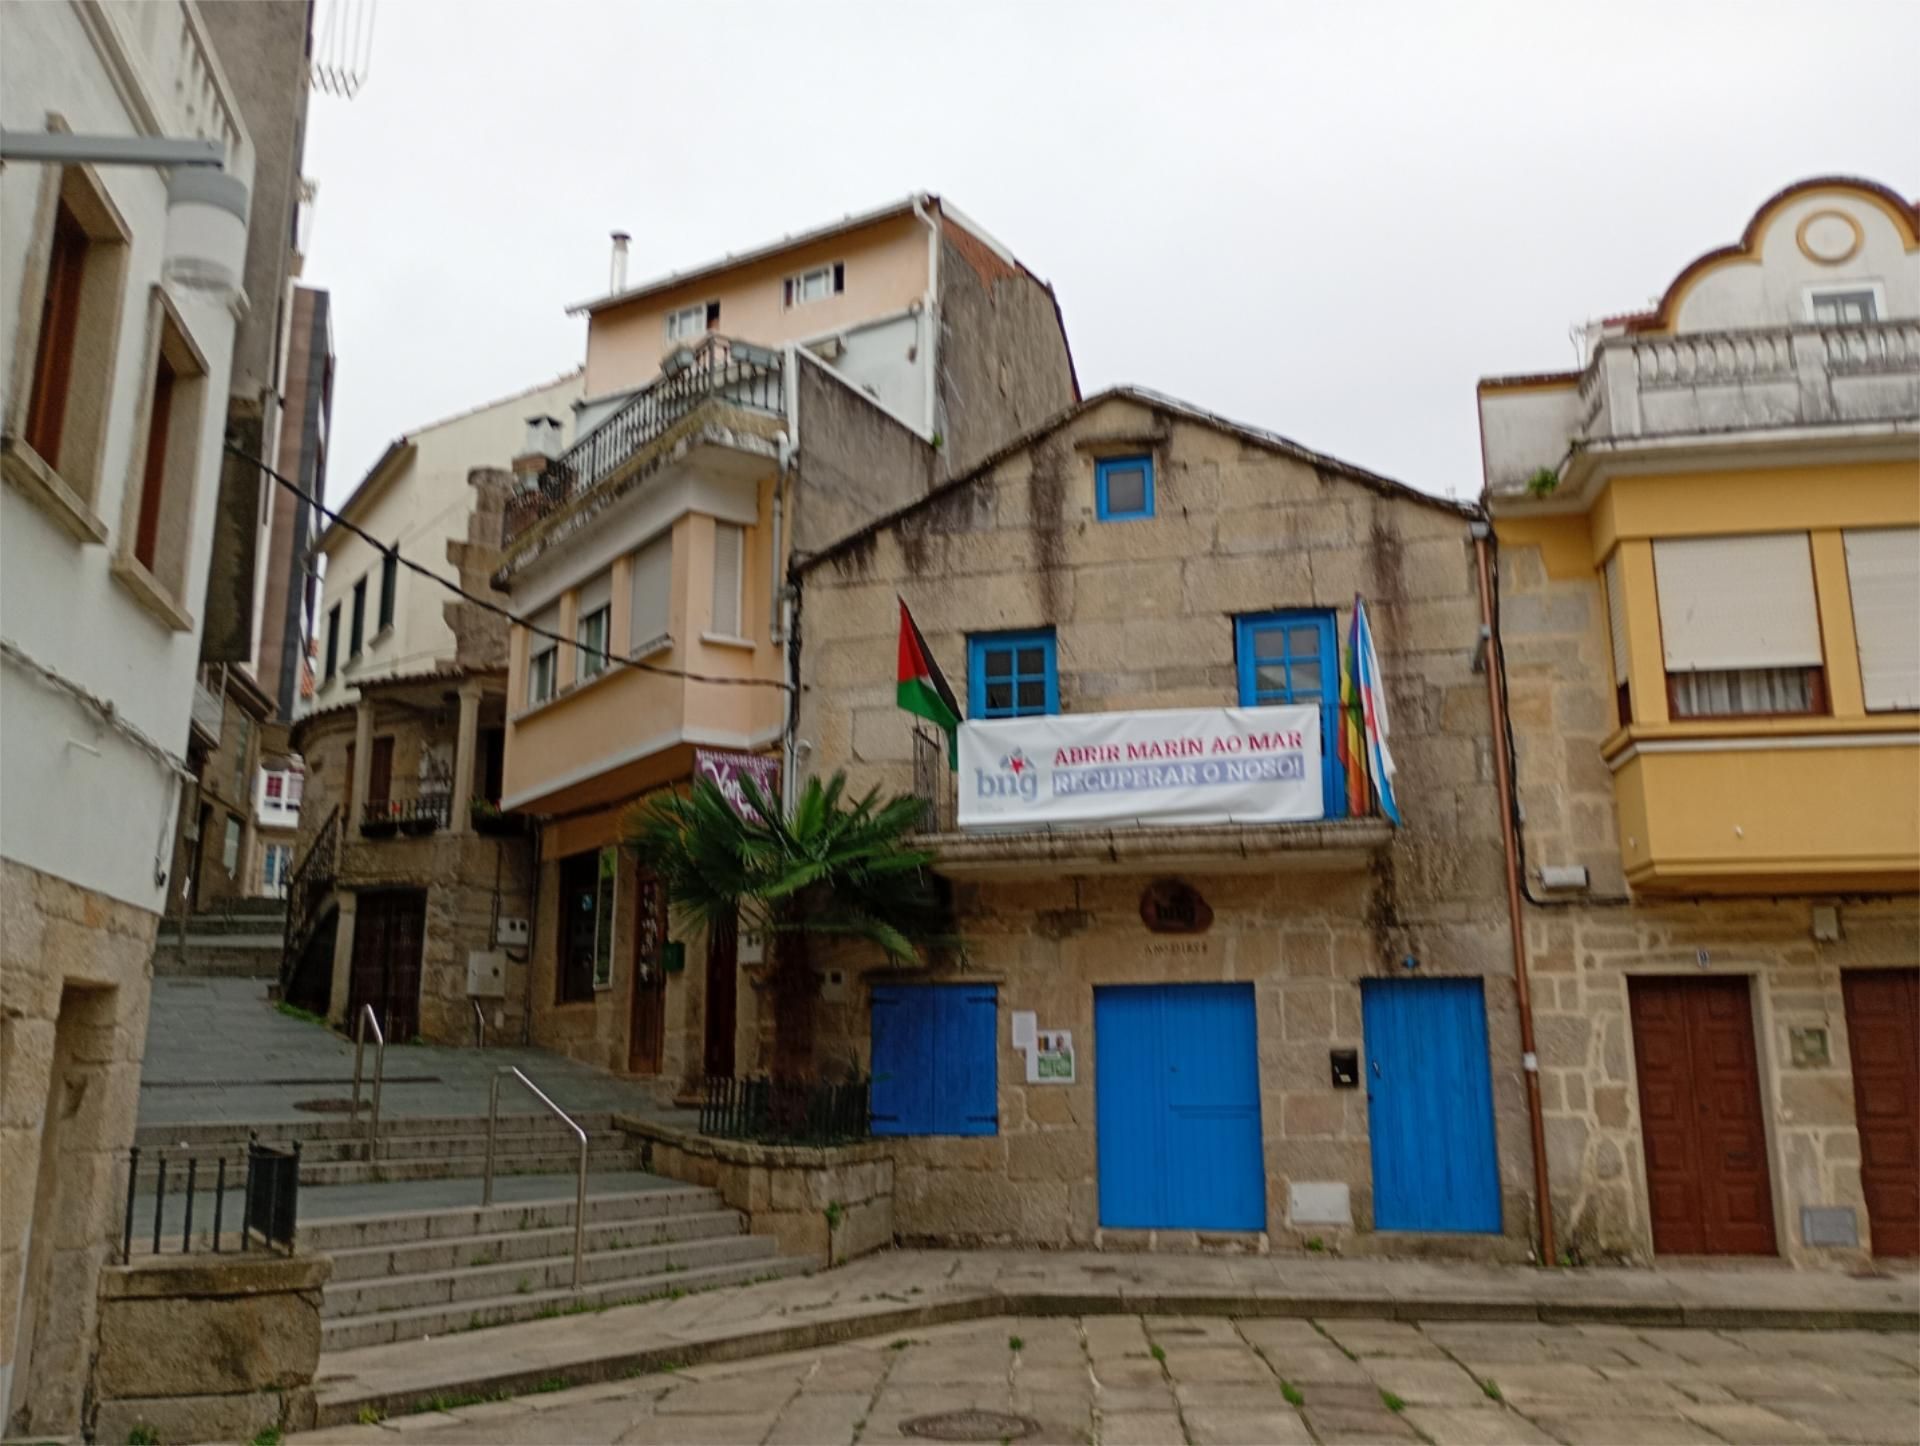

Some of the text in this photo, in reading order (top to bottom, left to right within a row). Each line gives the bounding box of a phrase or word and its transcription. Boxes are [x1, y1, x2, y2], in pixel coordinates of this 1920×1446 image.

[1054, 730, 1303, 767] ABRIR MARÍN AO MAR
[975, 767, 1038, 803] bng
[1055, 754, 1301, 794] RECUPERAR O NOSO!
